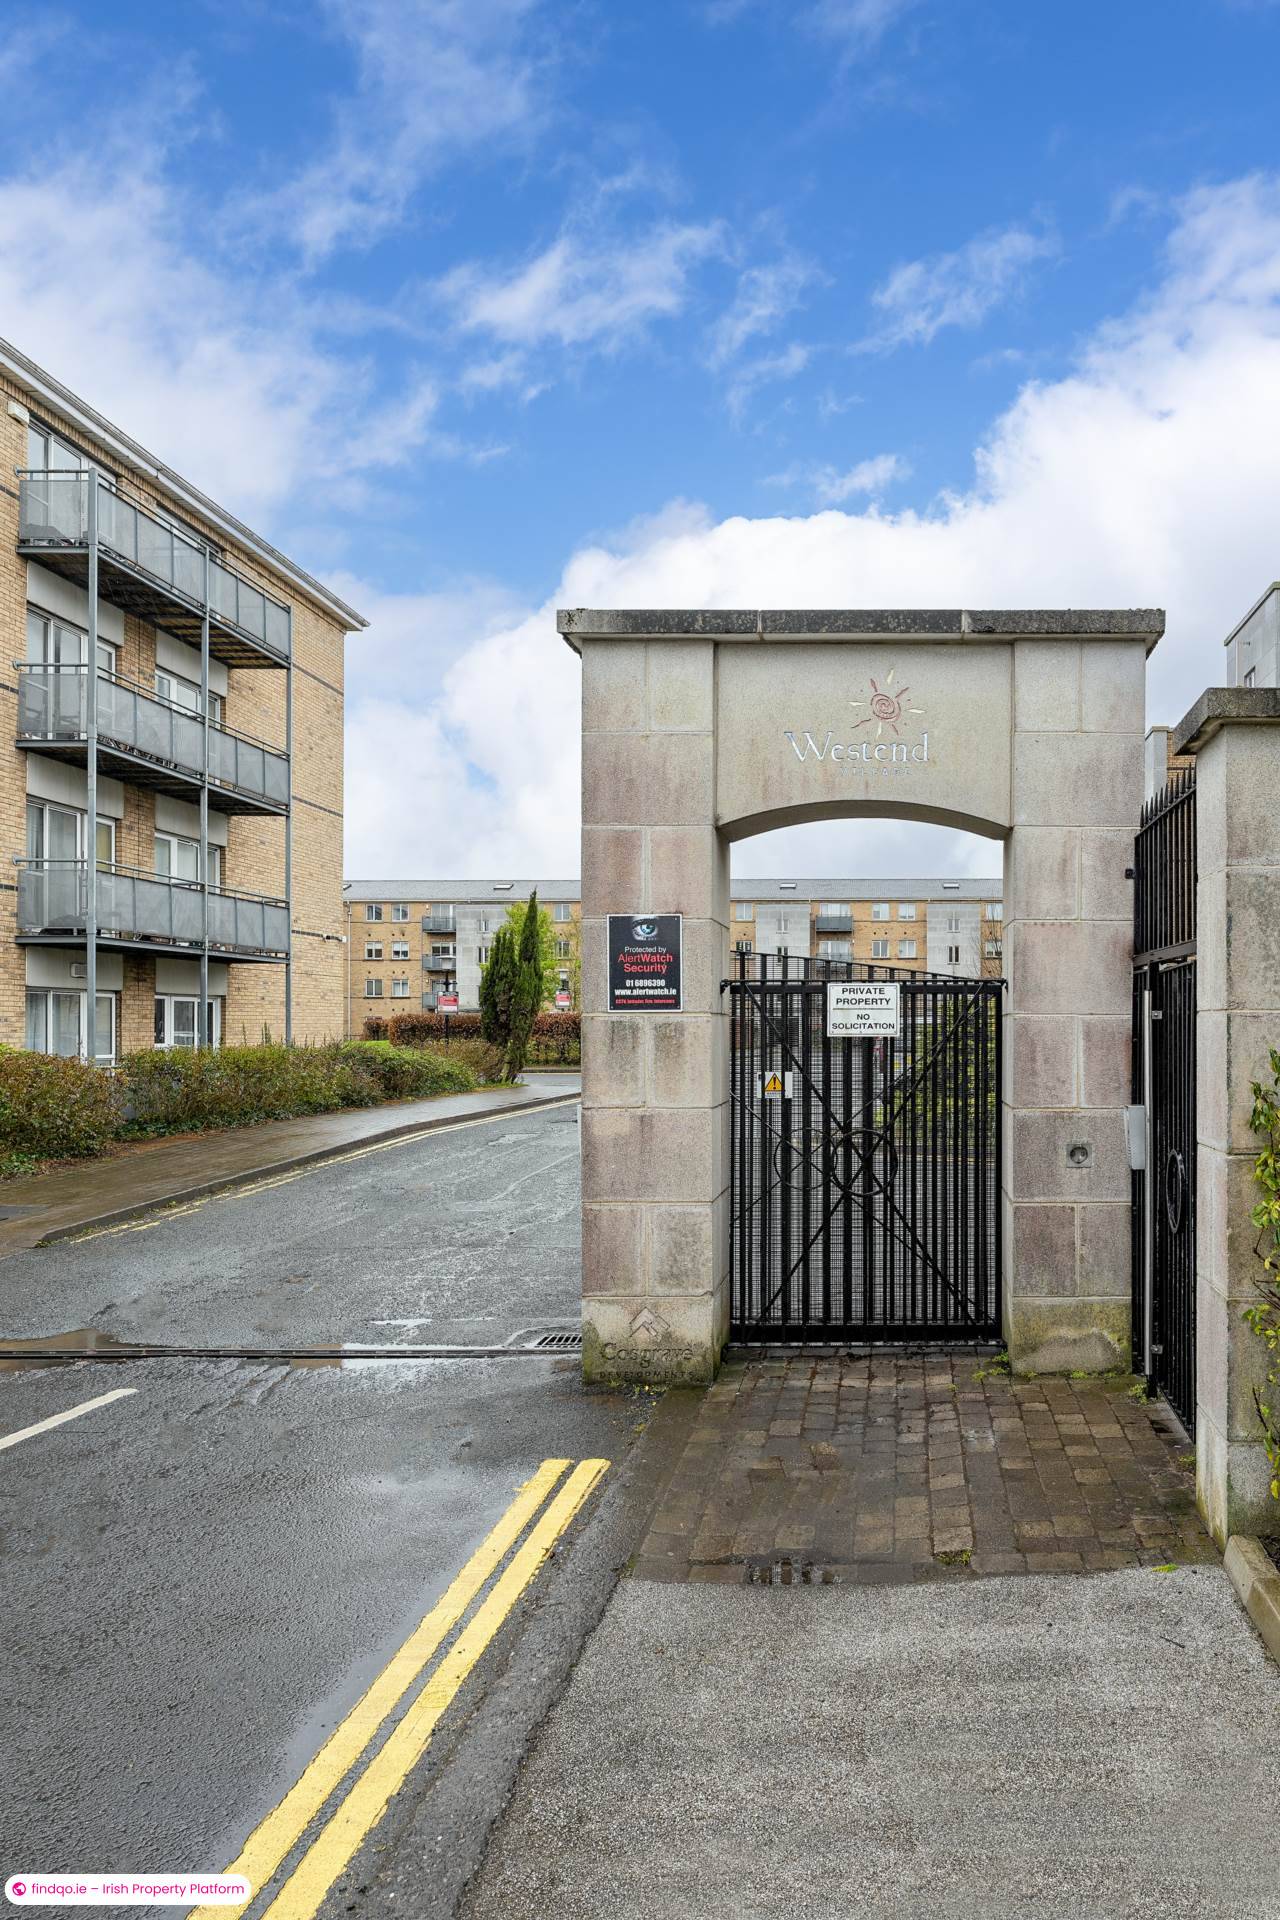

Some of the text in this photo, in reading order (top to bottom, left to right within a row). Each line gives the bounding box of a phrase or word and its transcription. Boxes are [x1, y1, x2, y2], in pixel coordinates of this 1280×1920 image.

[784, 731, 930, 762] Westend
[618, 954, 673, 962] AlertWatch
[624, 963, 667, 974] Security
[841, 987, 885, 995] PRIVATE
[836, 998, 891, 1006] PROPERTY
[832, 1022, 895, 1030] SOLICITATION
[601, 1342, 694, 1368] Cosgrave
[599, 1371, 695, 1380] DEVELOPMENTS
